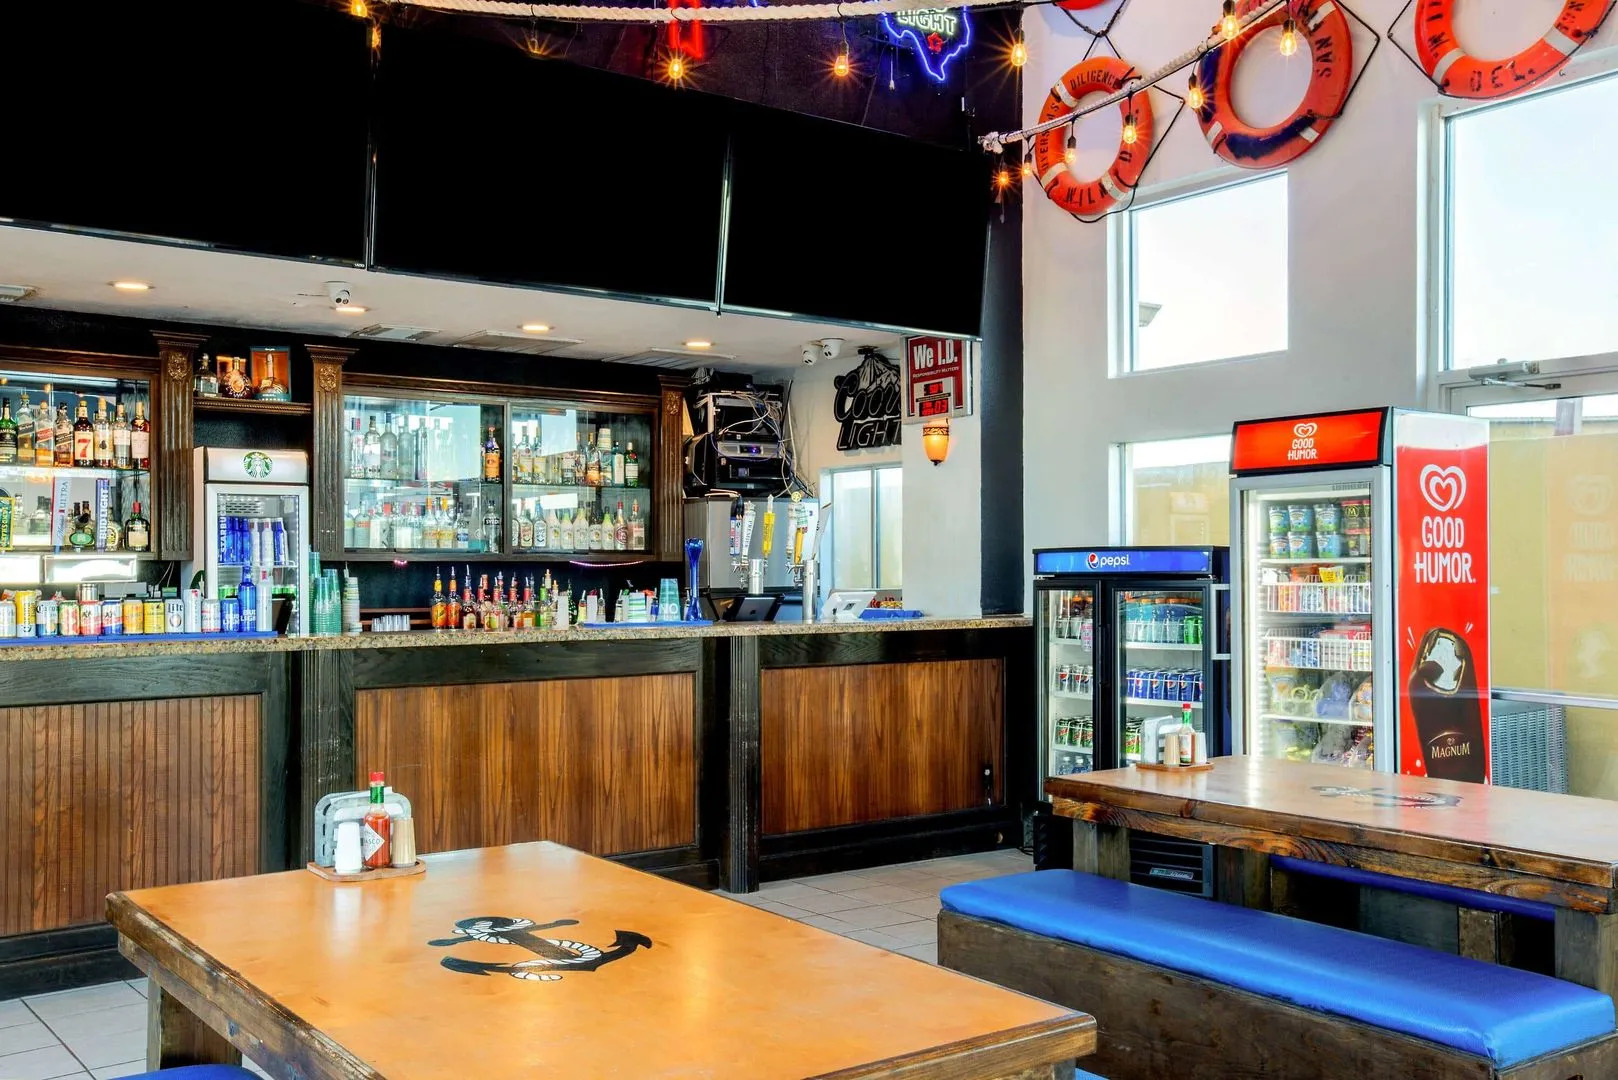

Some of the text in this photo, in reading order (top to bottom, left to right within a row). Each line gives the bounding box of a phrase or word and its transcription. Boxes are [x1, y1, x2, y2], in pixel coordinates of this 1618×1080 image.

[913, 339, 958, 370] We I.D.
[77, 438, 91, 458] 7
[1291, 437, 1314, 449] GOOD
[1421, 516, 1465, 549] GOOD
[1100, 554, 1130, 567] pepsi
[1431, 742, 1471, 759] MAGNUM
